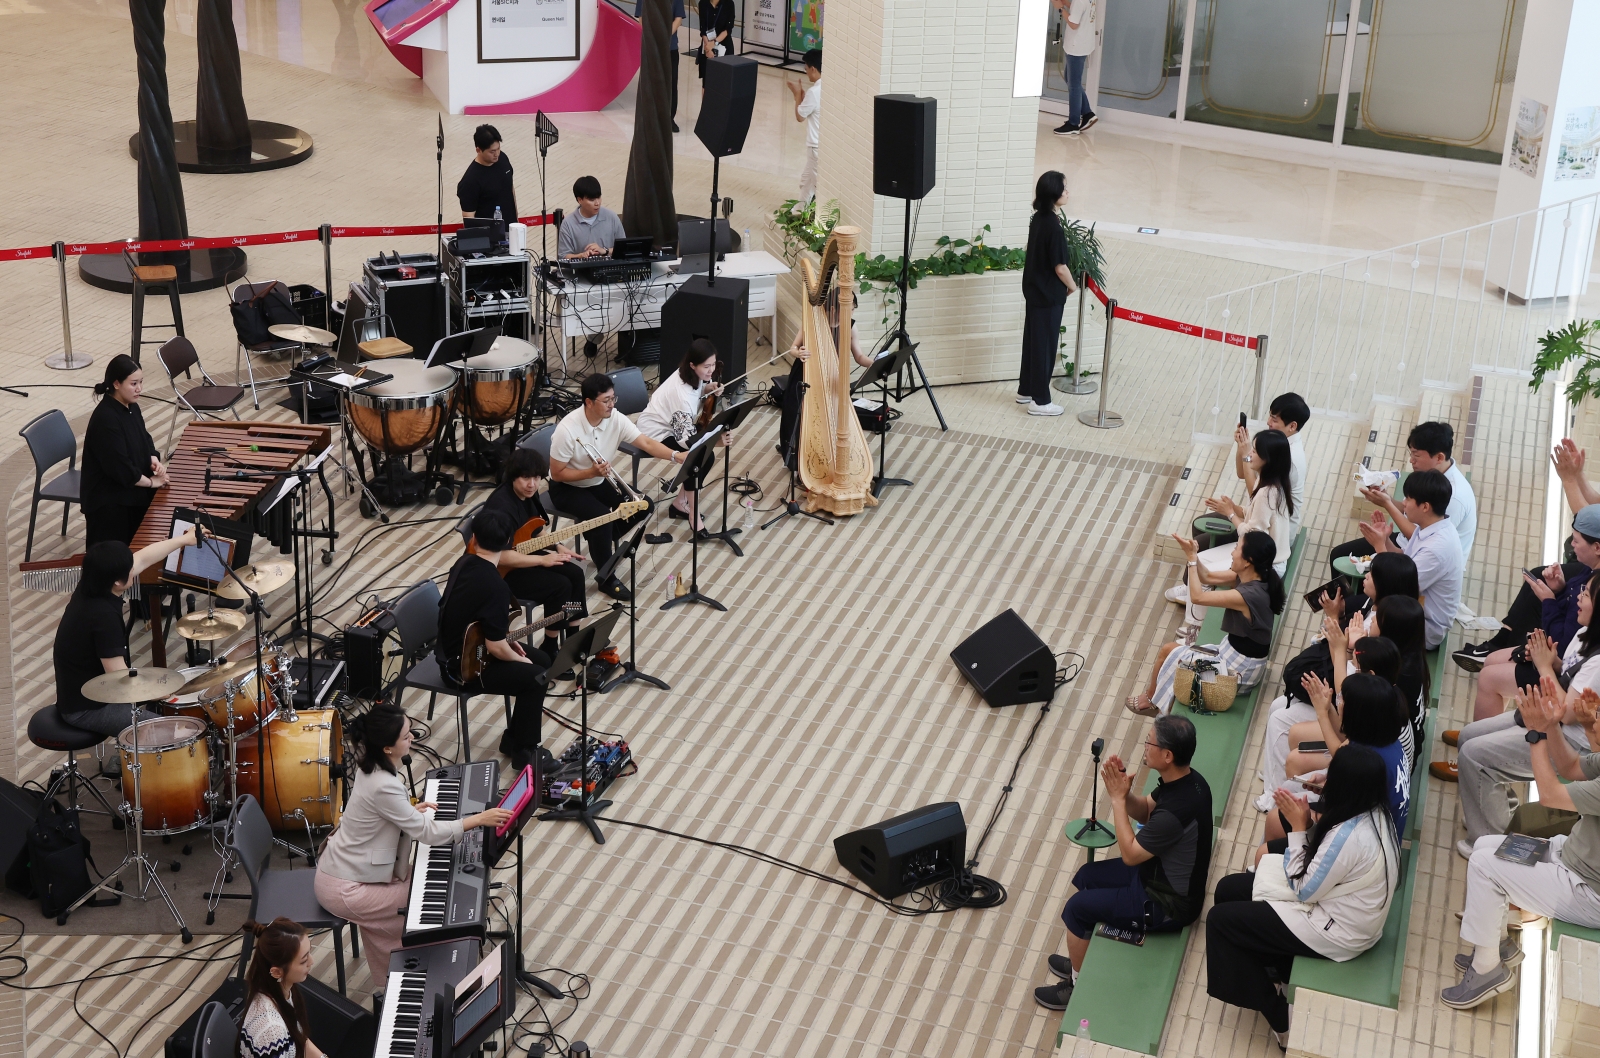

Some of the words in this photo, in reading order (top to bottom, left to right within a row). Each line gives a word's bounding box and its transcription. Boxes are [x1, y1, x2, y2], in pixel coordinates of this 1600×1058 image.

[232, 238, 247, 246] Starfield
[282, 233, 298, 242] Starfield
[126, 243, 142, 252] Starfield
[180, 240, 195, 249] Starfield
[15, 250, 32, 258] Starfield
[70, 245, 87, 254] Starfield
